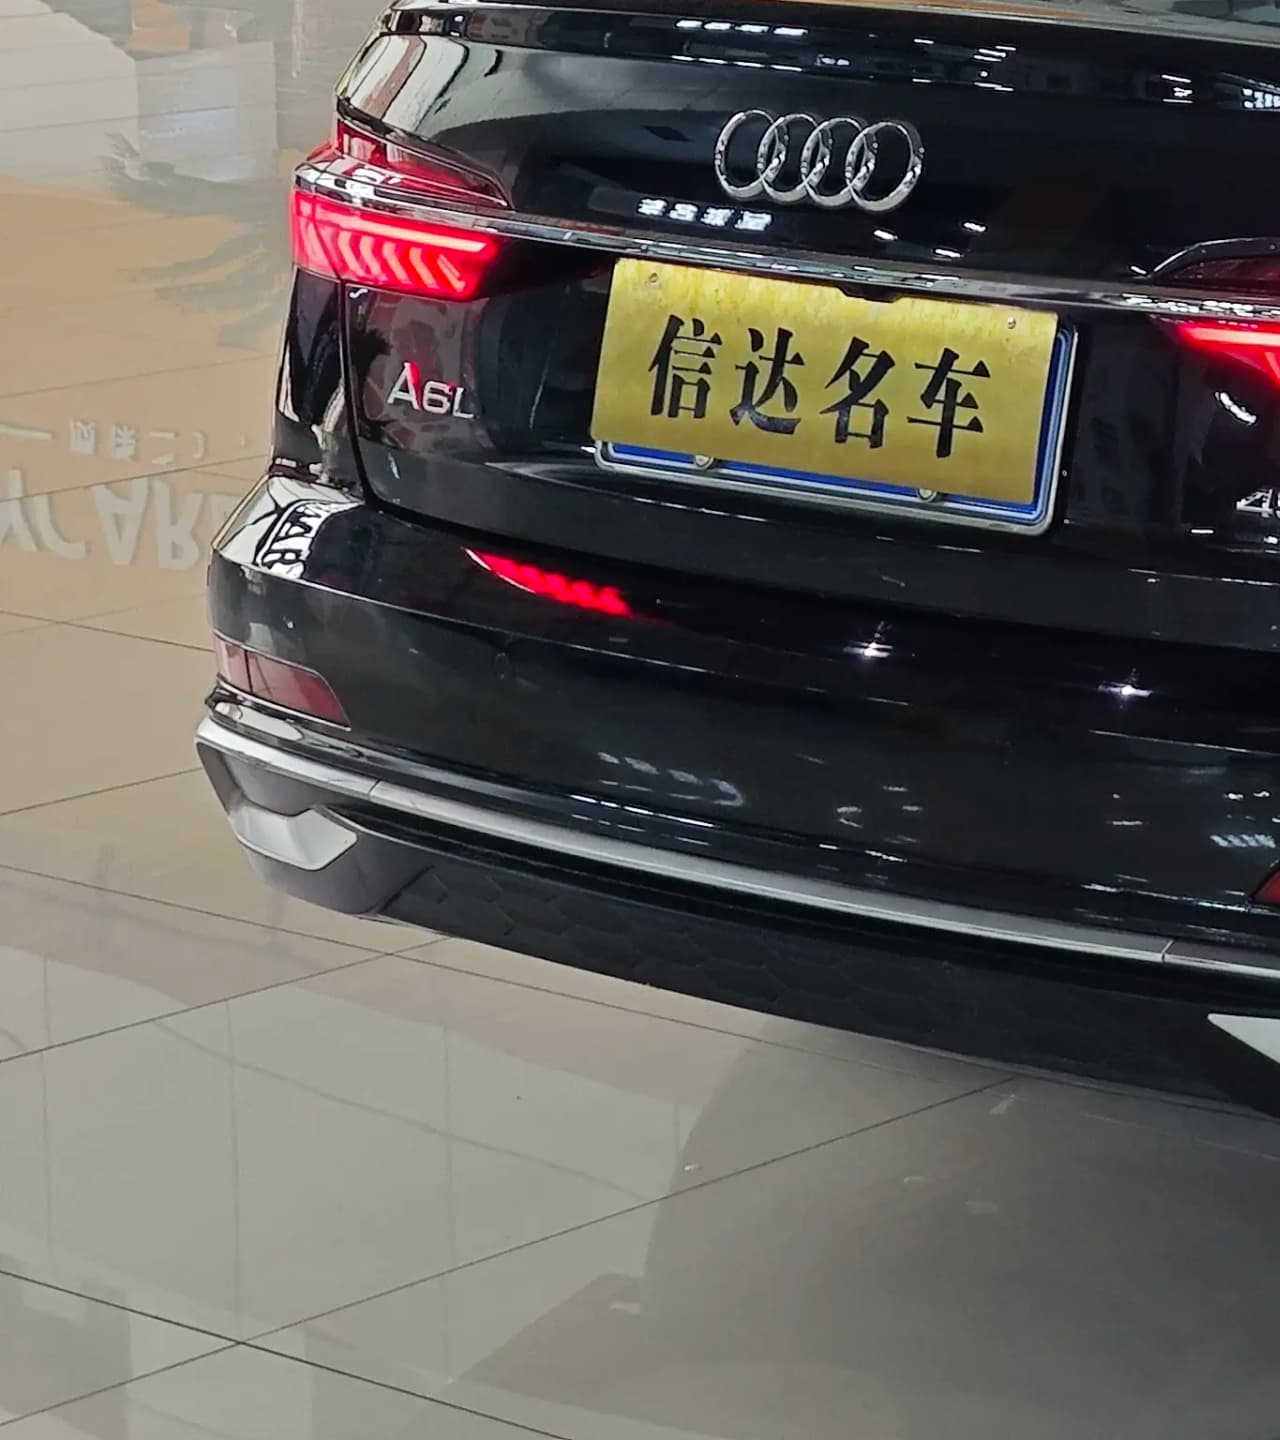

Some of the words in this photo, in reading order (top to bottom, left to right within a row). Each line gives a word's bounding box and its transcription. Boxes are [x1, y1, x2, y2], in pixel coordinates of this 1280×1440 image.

[386, 361, 475, 419] A6L
[648, 314, 992, 459] 信达名车
